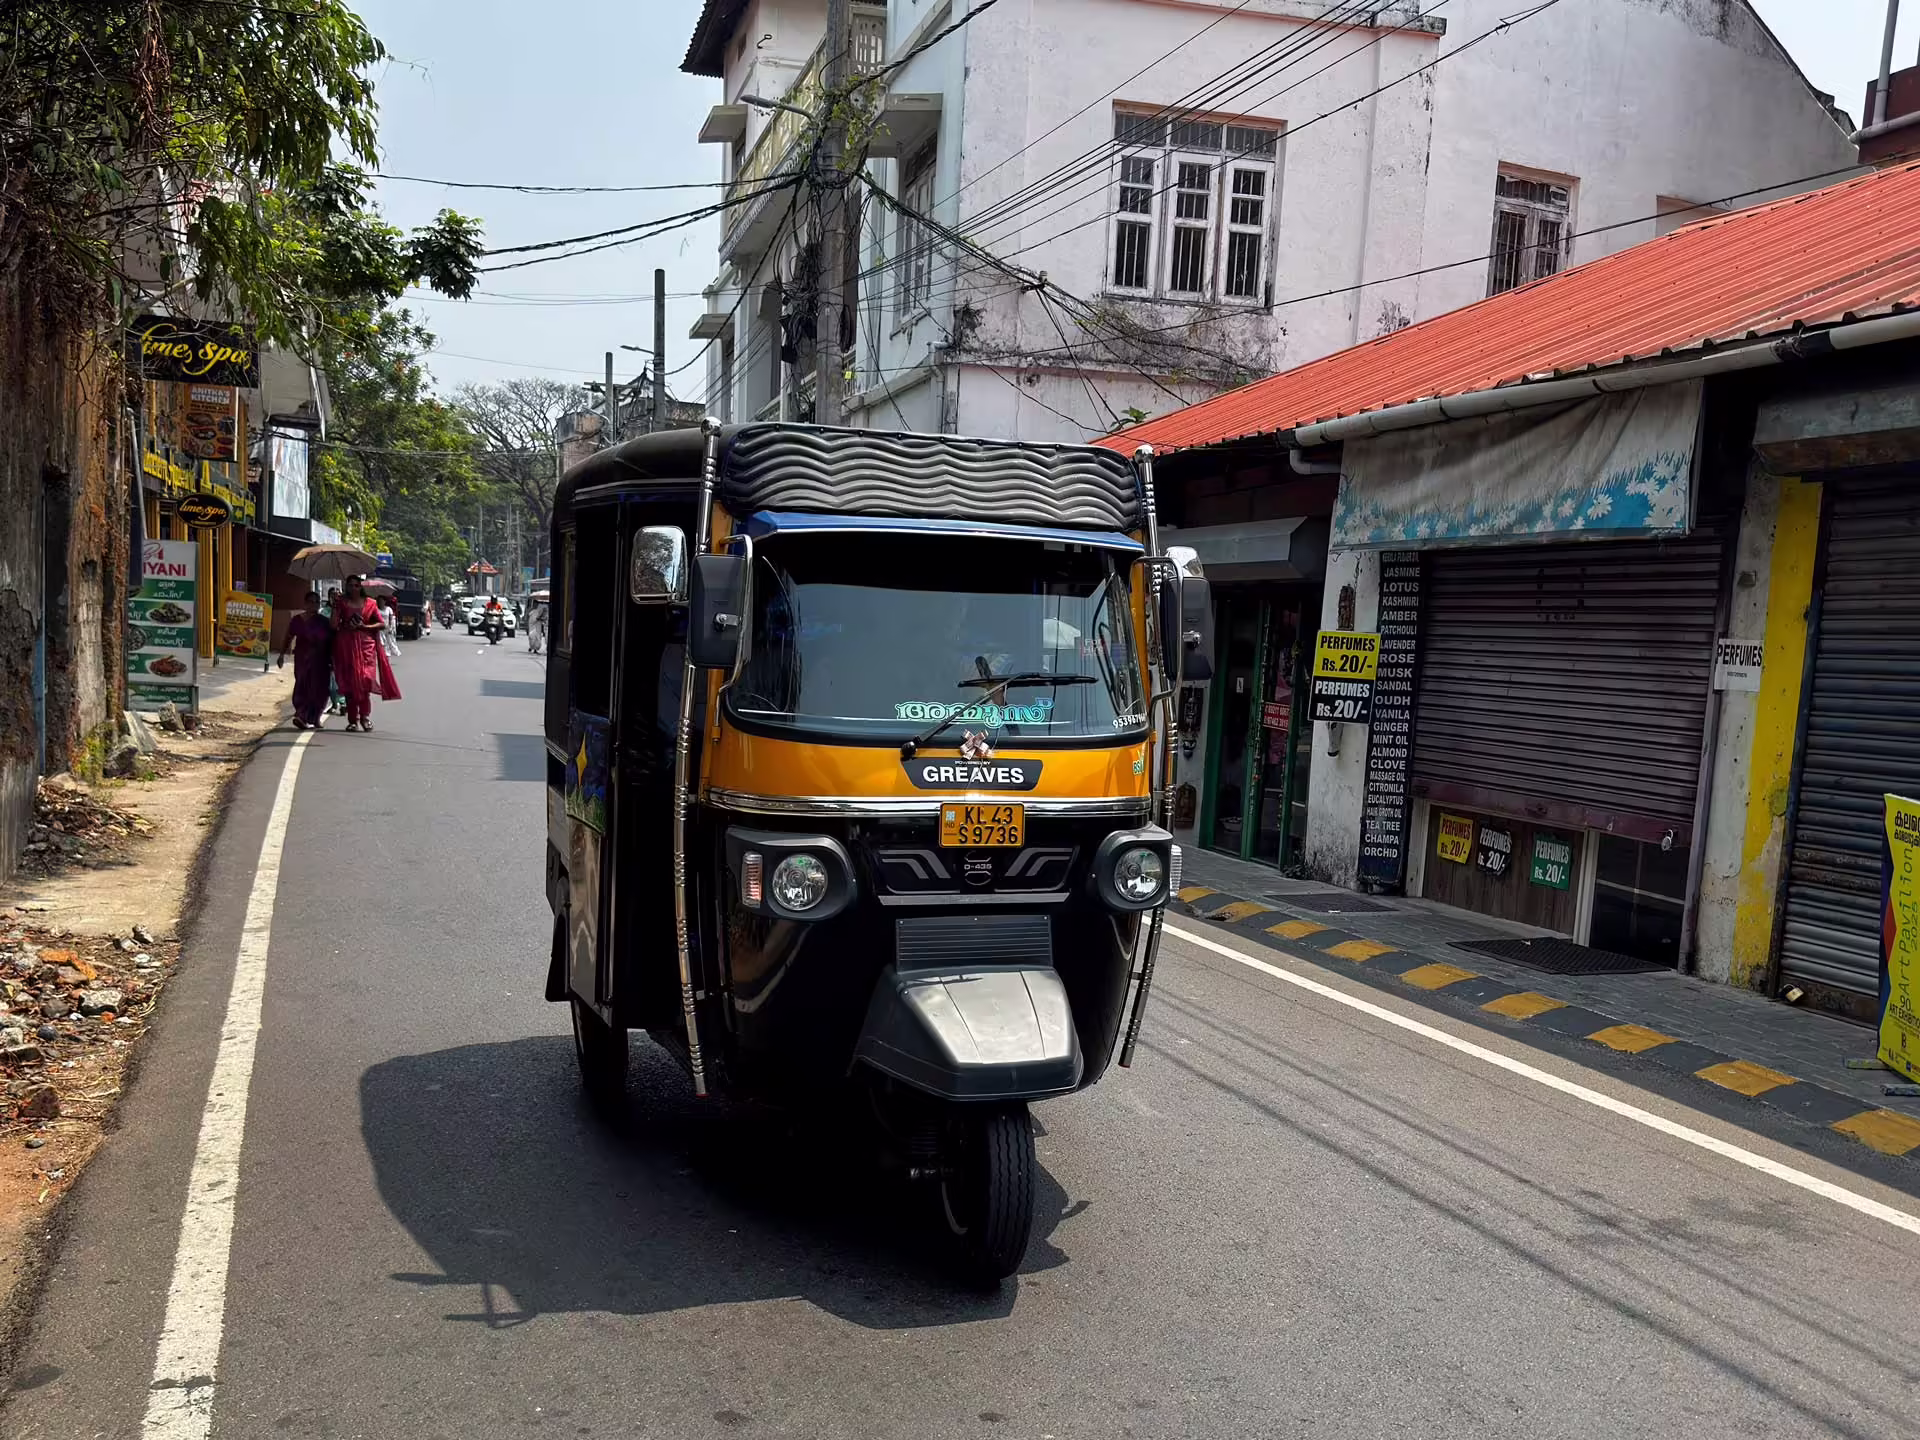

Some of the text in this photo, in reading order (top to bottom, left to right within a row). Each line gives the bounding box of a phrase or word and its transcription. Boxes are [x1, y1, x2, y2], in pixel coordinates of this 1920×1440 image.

[1384, 567, 1420, 577] JASMINE
[1384, 582, 1419, 592] LOTUS
[1382, 596, 1418, 606] KASHMIRI
[226, 608, 264, 618] KITCHEN
[1382, 611, 1417, 621] AMBER
[1381, 625, 1416, 634] PATCHOULI
[1320, 636, 1375, 652] PERFUMES
[1380, 640, 1416, 650] LAVENDER
[1380, 654, 1416, 663] ROSE
[1717, 645, 1763, 667] PERFUMES
[1378, 668, 1412, 678] MUSK
[1315, 681, 1370, 698] PERFUMES
[1377, 681, 1412, 690] SANDAL
[1375, 696, 1410, 706] OUDH
[1375, 709, 1410, 720] VANILA
[1373, 722, 1408, 732] GINGER
[1372, 735, 1408, 745] MINT OIL
[1371, 747, 1407, 757] ALMOND
[1370, 760, 1406, 770] CLOVE
[922, 766, 1024, 784] GREAVES
[1370, 771, 1405, 782] MASSAGE OIL
[1369, 783, 1404, 793] CITRONILA
[1368, 795, 1403, 805] EUCALYPTUS
[965, 806, 1013, 825] KL 43
[1366, 820, 1400, 831] TEA TREE
[1441, 818, 1471, 840] PERFUMES
[1365, 834, 1399, 845] CHAMPA
[1480, 828, 1511, 853] PERFUMES
[1364, 847, 1398, 858] ORCHID
[1535, 840, 1569, 864] PERFUMES
[1898, 848, 1912, 954] Pavilion
[1898, 956, 1910, 996] Art
